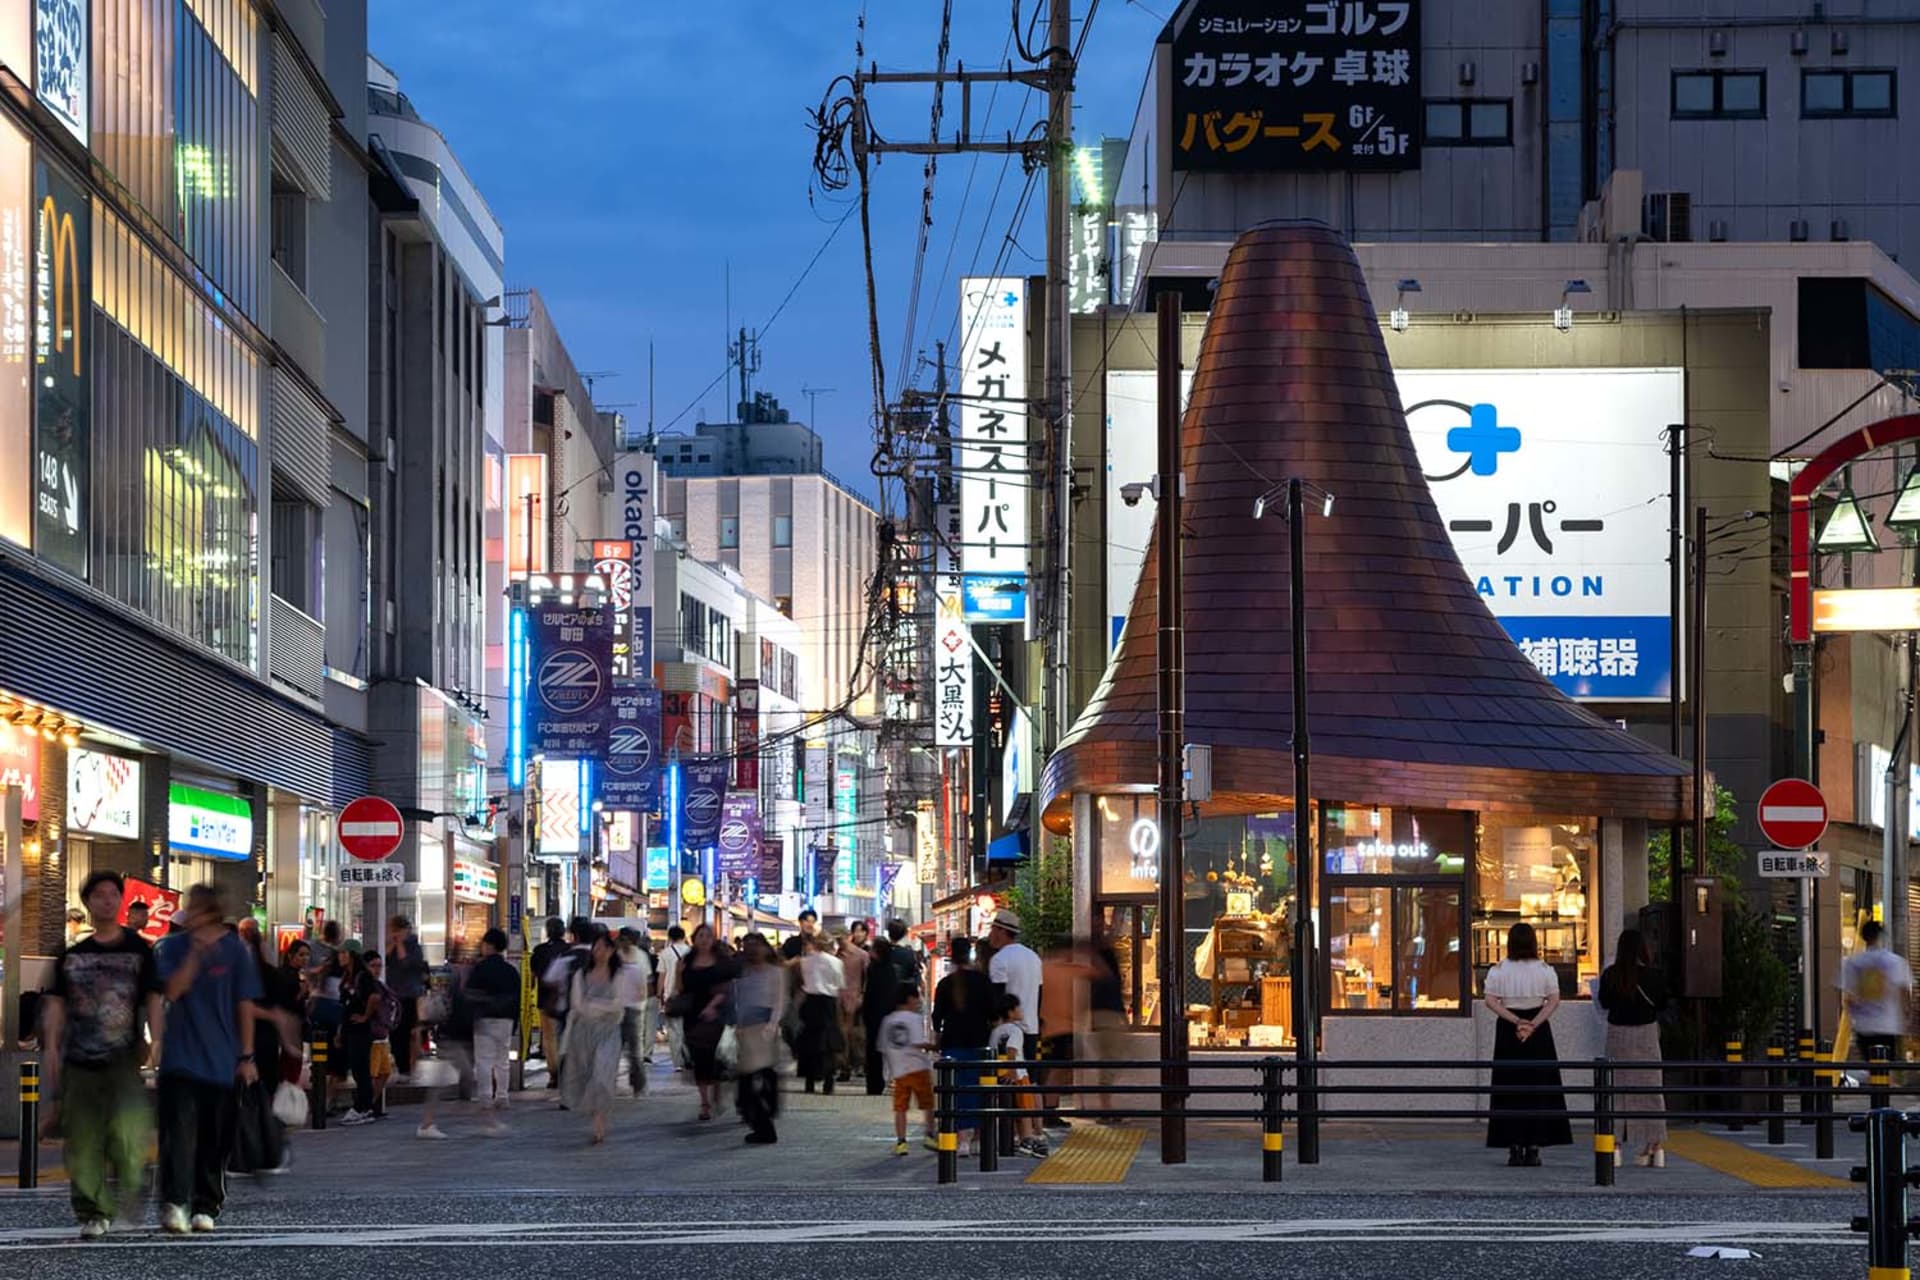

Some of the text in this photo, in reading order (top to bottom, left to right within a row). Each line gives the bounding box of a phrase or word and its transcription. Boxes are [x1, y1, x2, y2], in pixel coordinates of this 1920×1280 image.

[1198, 0, 1410, 36] シミュレーション ゴルフ
[1182, 48, 1411, 88] カラオケ 卓球
[1178, 109, 1343, 153] バグース
[1377, 126, 1410, 155] 5F
[1352, 143, 1374, 155] 受付
[1082, 213, 1101, 293] ビリヤード
[977, 340, 1011, 559] メガネスーパー
[39, 450, 58, 490] 148
[39, 491, 58, 519] SEATS
[560, 627, 584, 642] 町田
[1519, 637, 1639, 677] 補聴器
[939, 657, 973, 742] 大黒さん
[1358, 841, 1429, 858] take out
[1761, 857, 1826, 874] 自転車を除く
[340, 867, 402, 883] 自転車を除く
[1129, 859, 1158, 879] info
